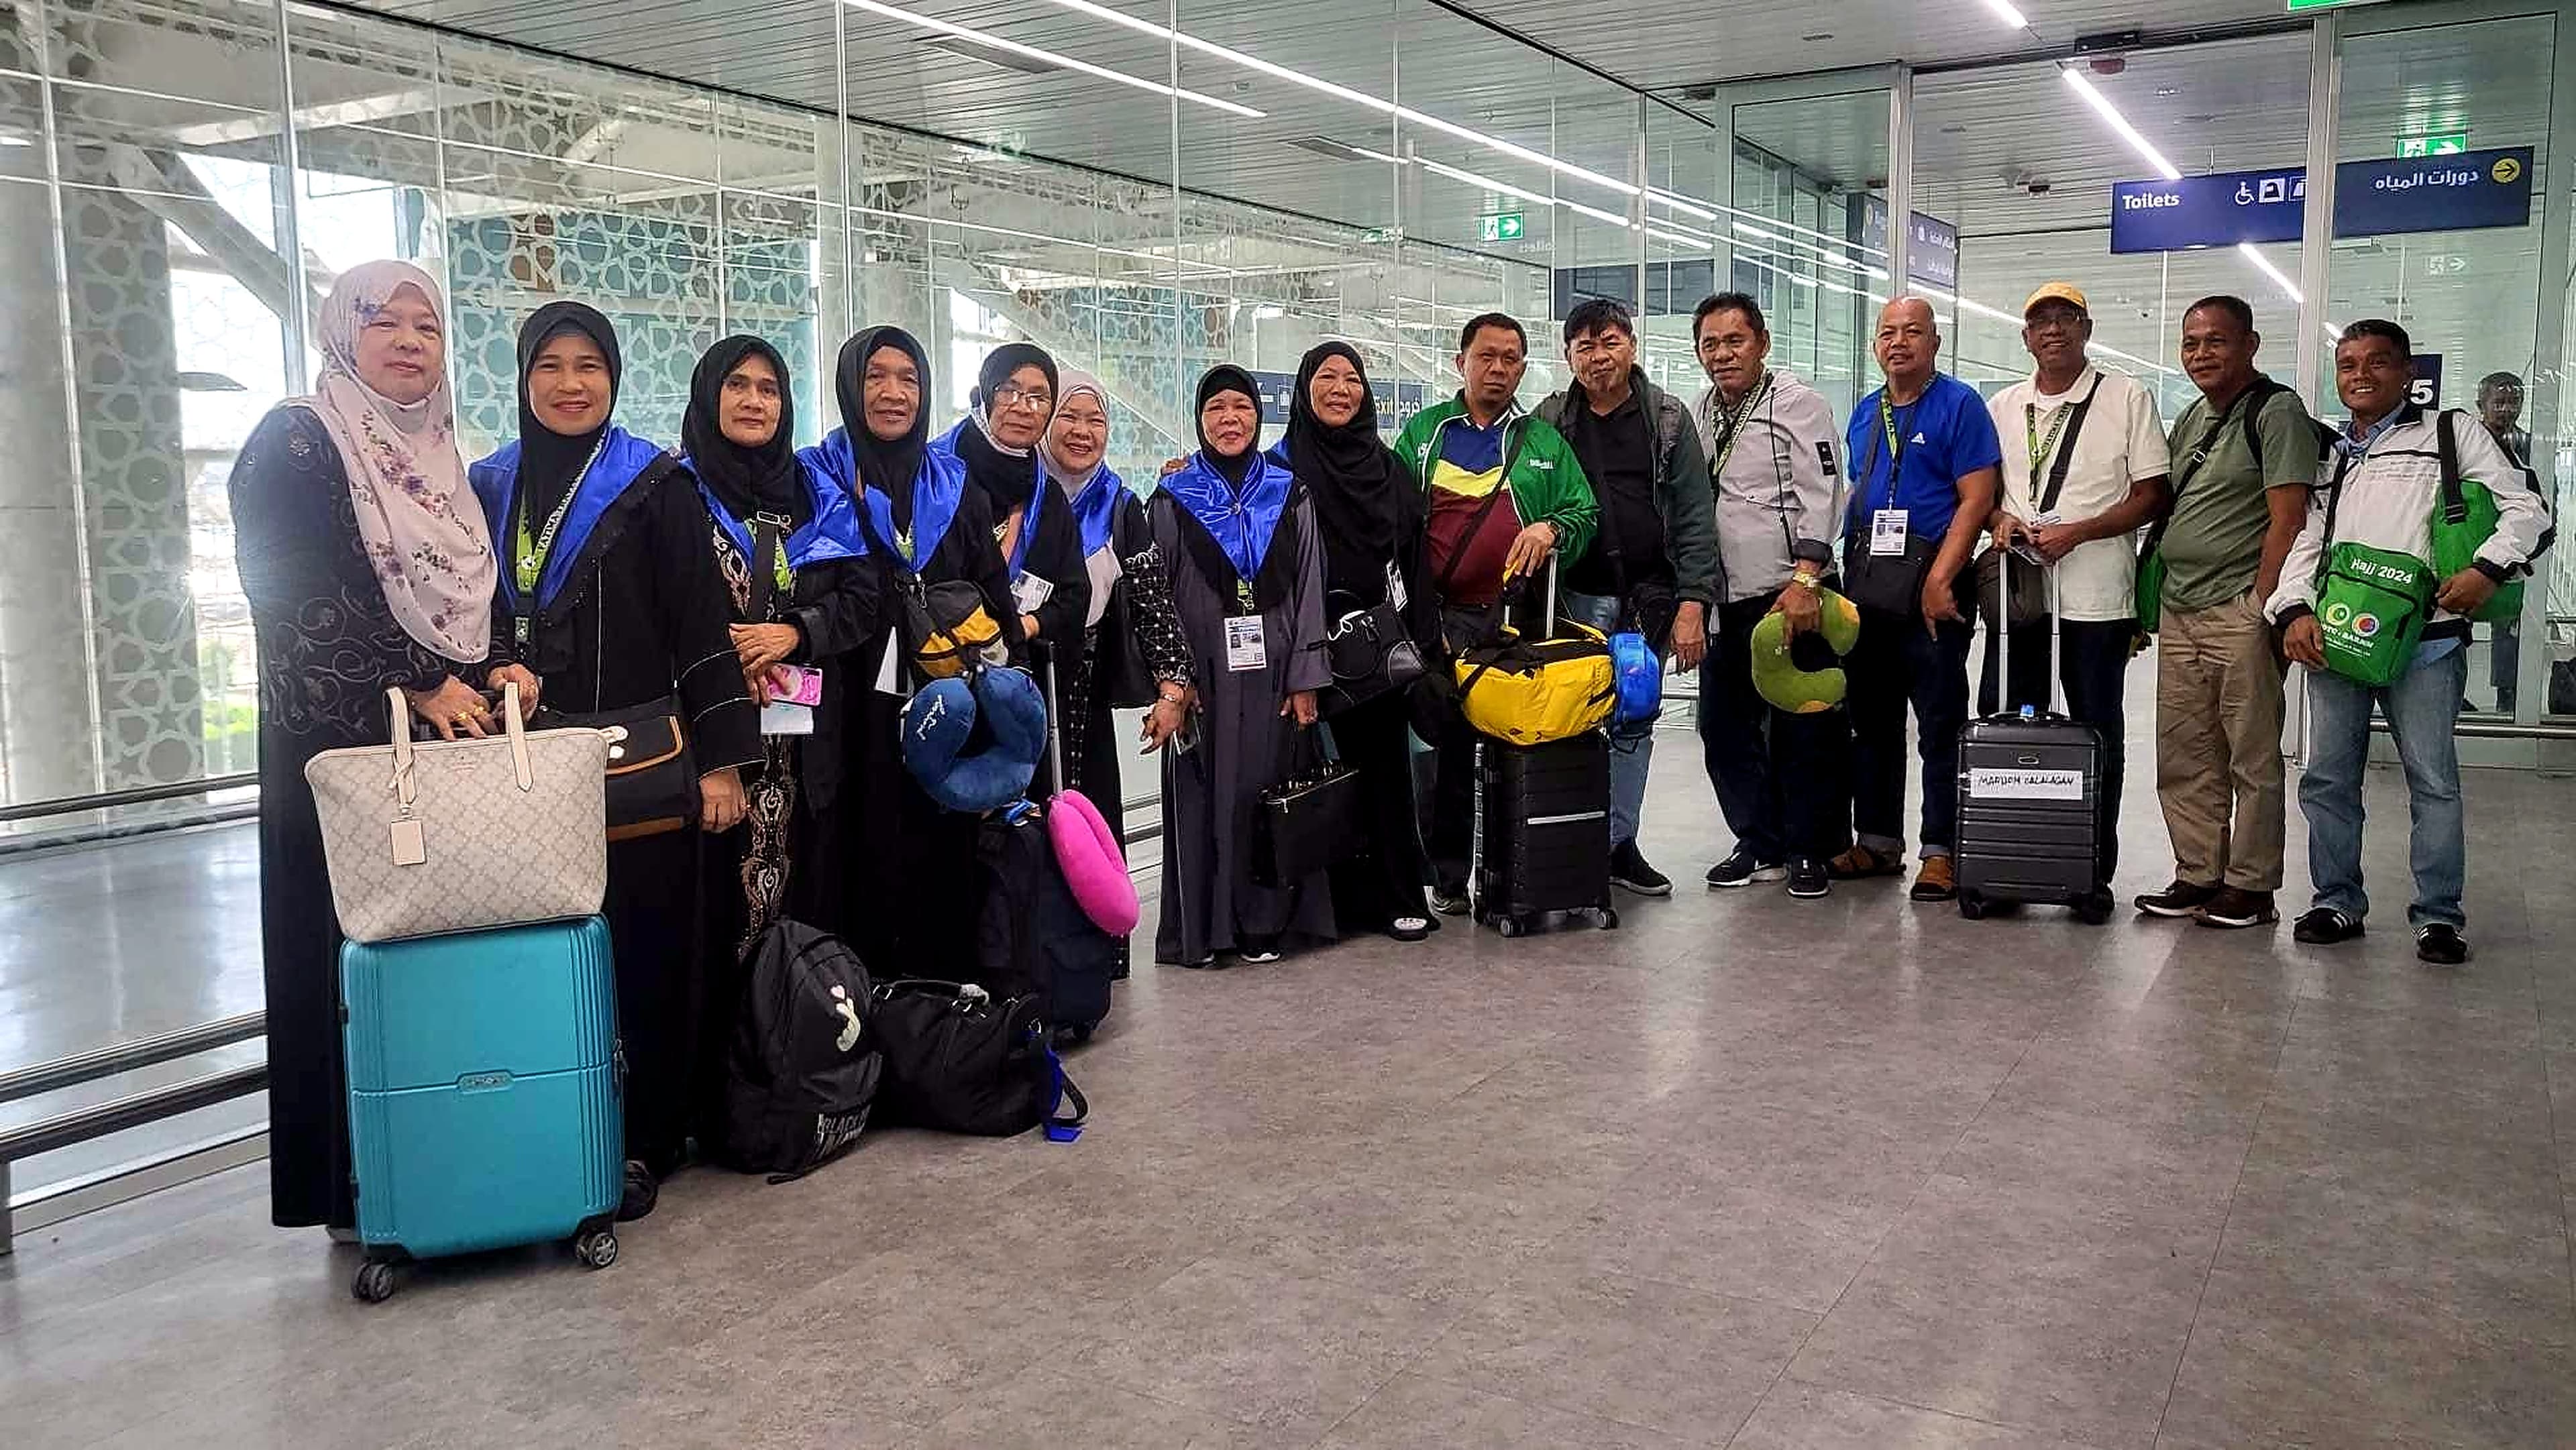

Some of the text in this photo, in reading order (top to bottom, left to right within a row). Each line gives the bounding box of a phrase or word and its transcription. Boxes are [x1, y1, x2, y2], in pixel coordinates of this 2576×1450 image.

[2375, 169, 2479, 191] دورات المياه
[2122, 192, 2180, 209] Toilets
[2410, 379, 2433, 404] 5
[2350, 558, 2413, 584] Hajj 2024
